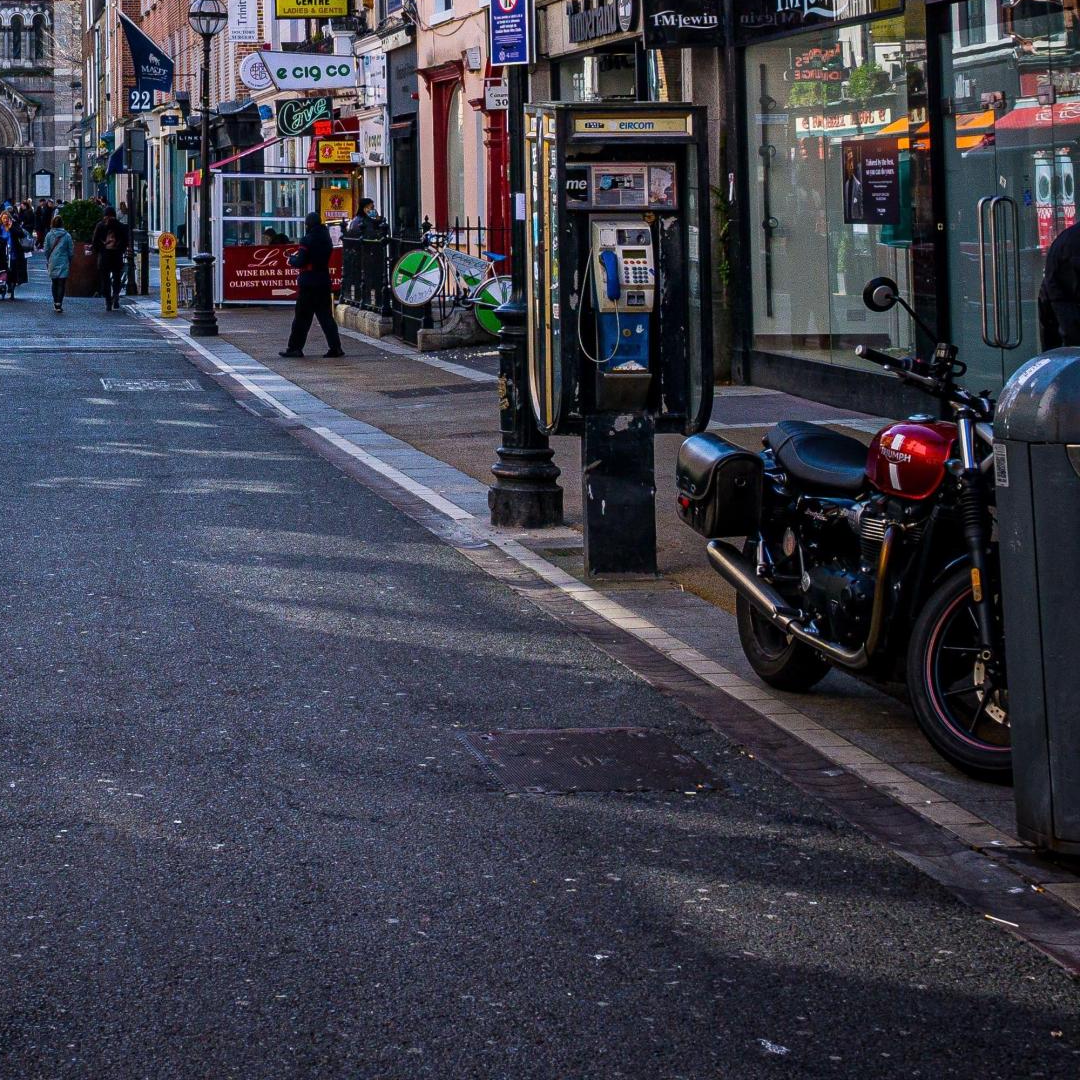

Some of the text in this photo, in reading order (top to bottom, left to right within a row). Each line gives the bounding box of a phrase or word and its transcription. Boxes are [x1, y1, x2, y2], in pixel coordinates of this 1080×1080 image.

[276, 67, 288, 79] e
[292, 65, 322, 82] cig
[326, 63, 350, 77] co
[130, 91, 151, 110] 22
[278, 99, 331, 136] Cave
[229, 280, 260, 288] OLDEST
[261, 279, 284, 287] WINE
[881, 446, 912, 463] TRIUMPH
